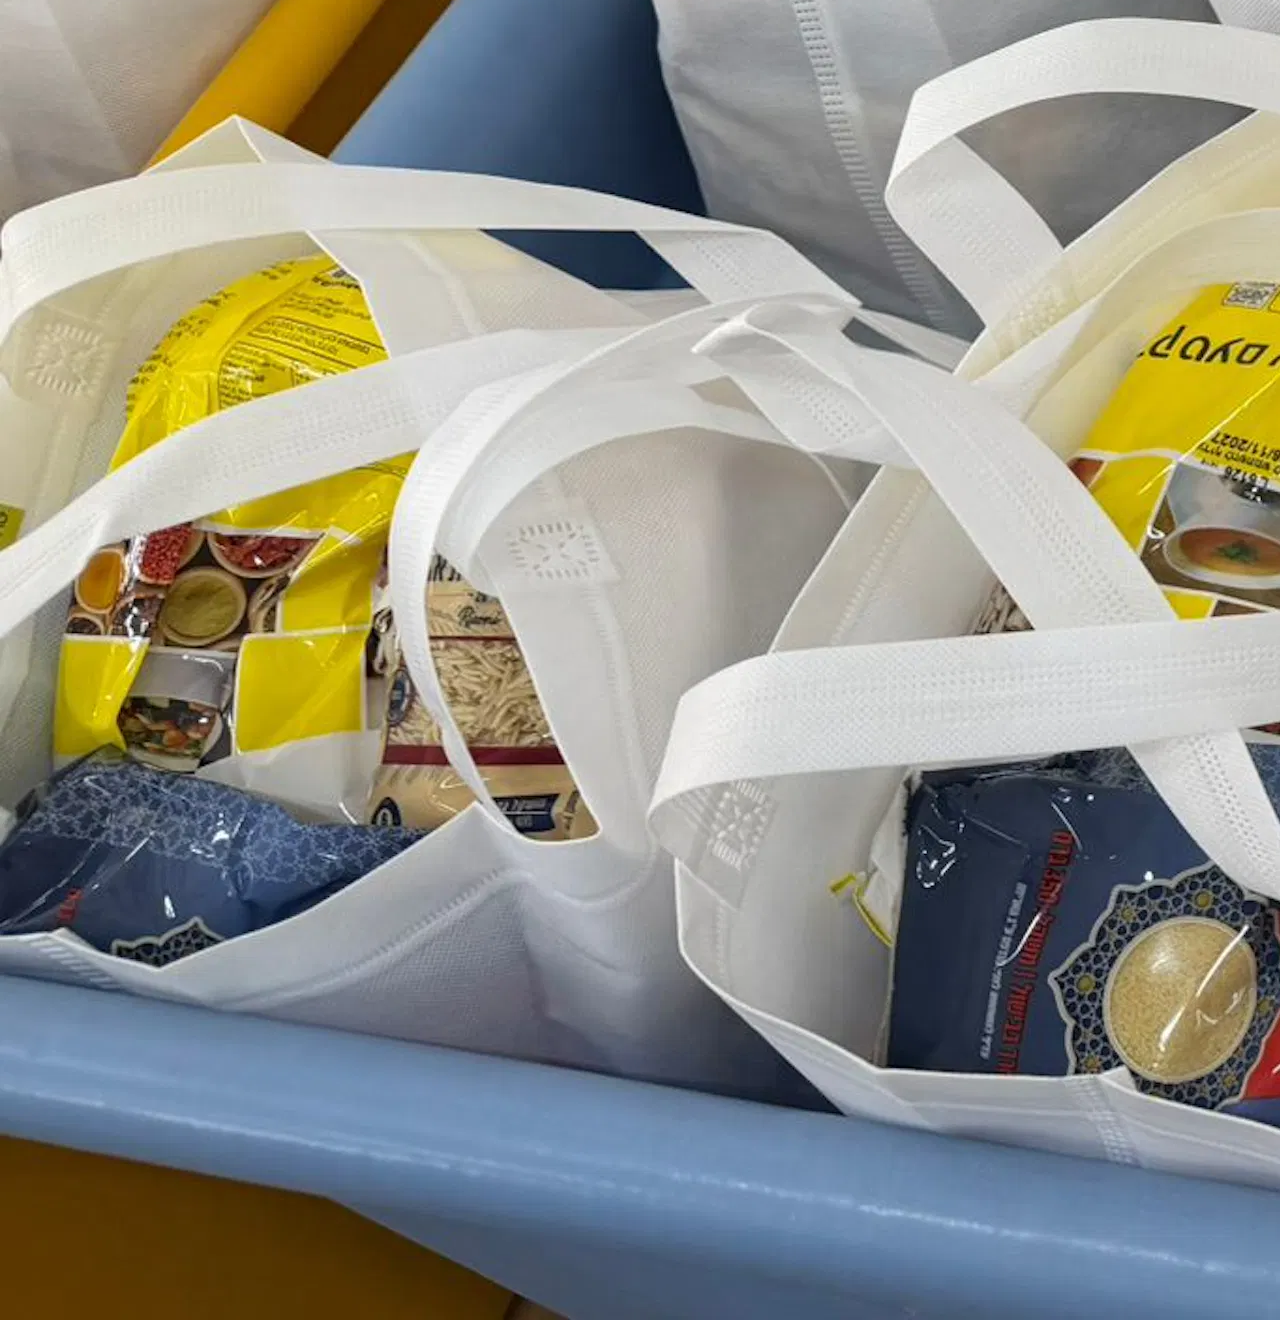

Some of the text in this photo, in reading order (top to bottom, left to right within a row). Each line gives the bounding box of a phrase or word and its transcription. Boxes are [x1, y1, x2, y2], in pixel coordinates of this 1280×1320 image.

[1046, 830, 1076, 867] גרם
[1037, 868, 1067, 904] 350
[1000, 983, 1036, 1046] בבישול
